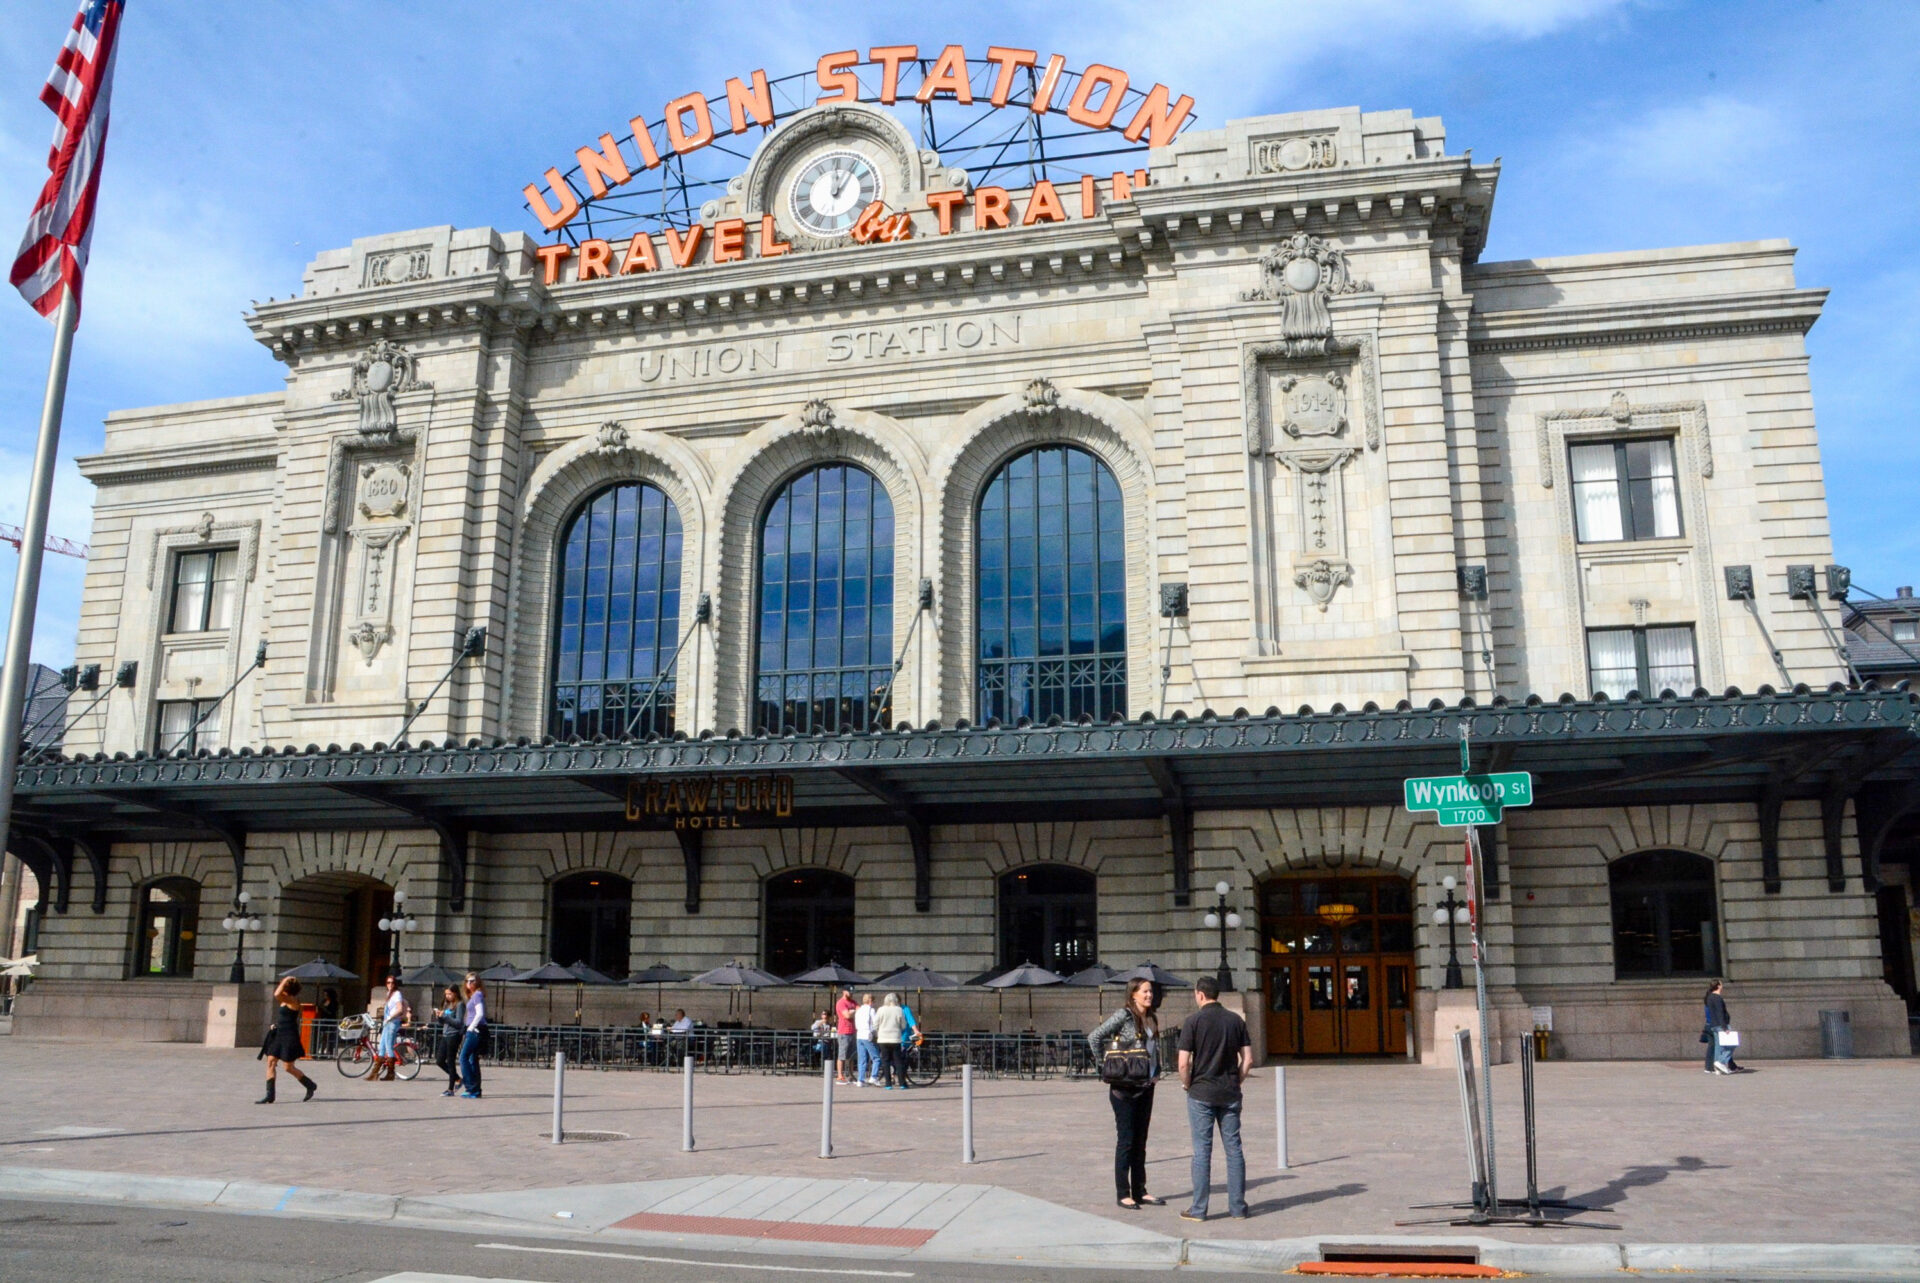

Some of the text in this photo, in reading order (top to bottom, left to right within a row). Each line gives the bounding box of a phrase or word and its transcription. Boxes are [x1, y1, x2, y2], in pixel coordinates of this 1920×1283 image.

[523, 44, 1194, 231] UNION STATION
[536, 214, 791, 285] TRAVEL
[640, 315, 1021, 383] UNION STATION
[1291, 392, 1335, 414] 1914
[626, 775, 794, 821] CRAWFORD
[1412, 780, 1526, 806] Wynkoop St
[675, 815, 741, 829] HOTEL
[1454, 809, 1486, 823] 1700
